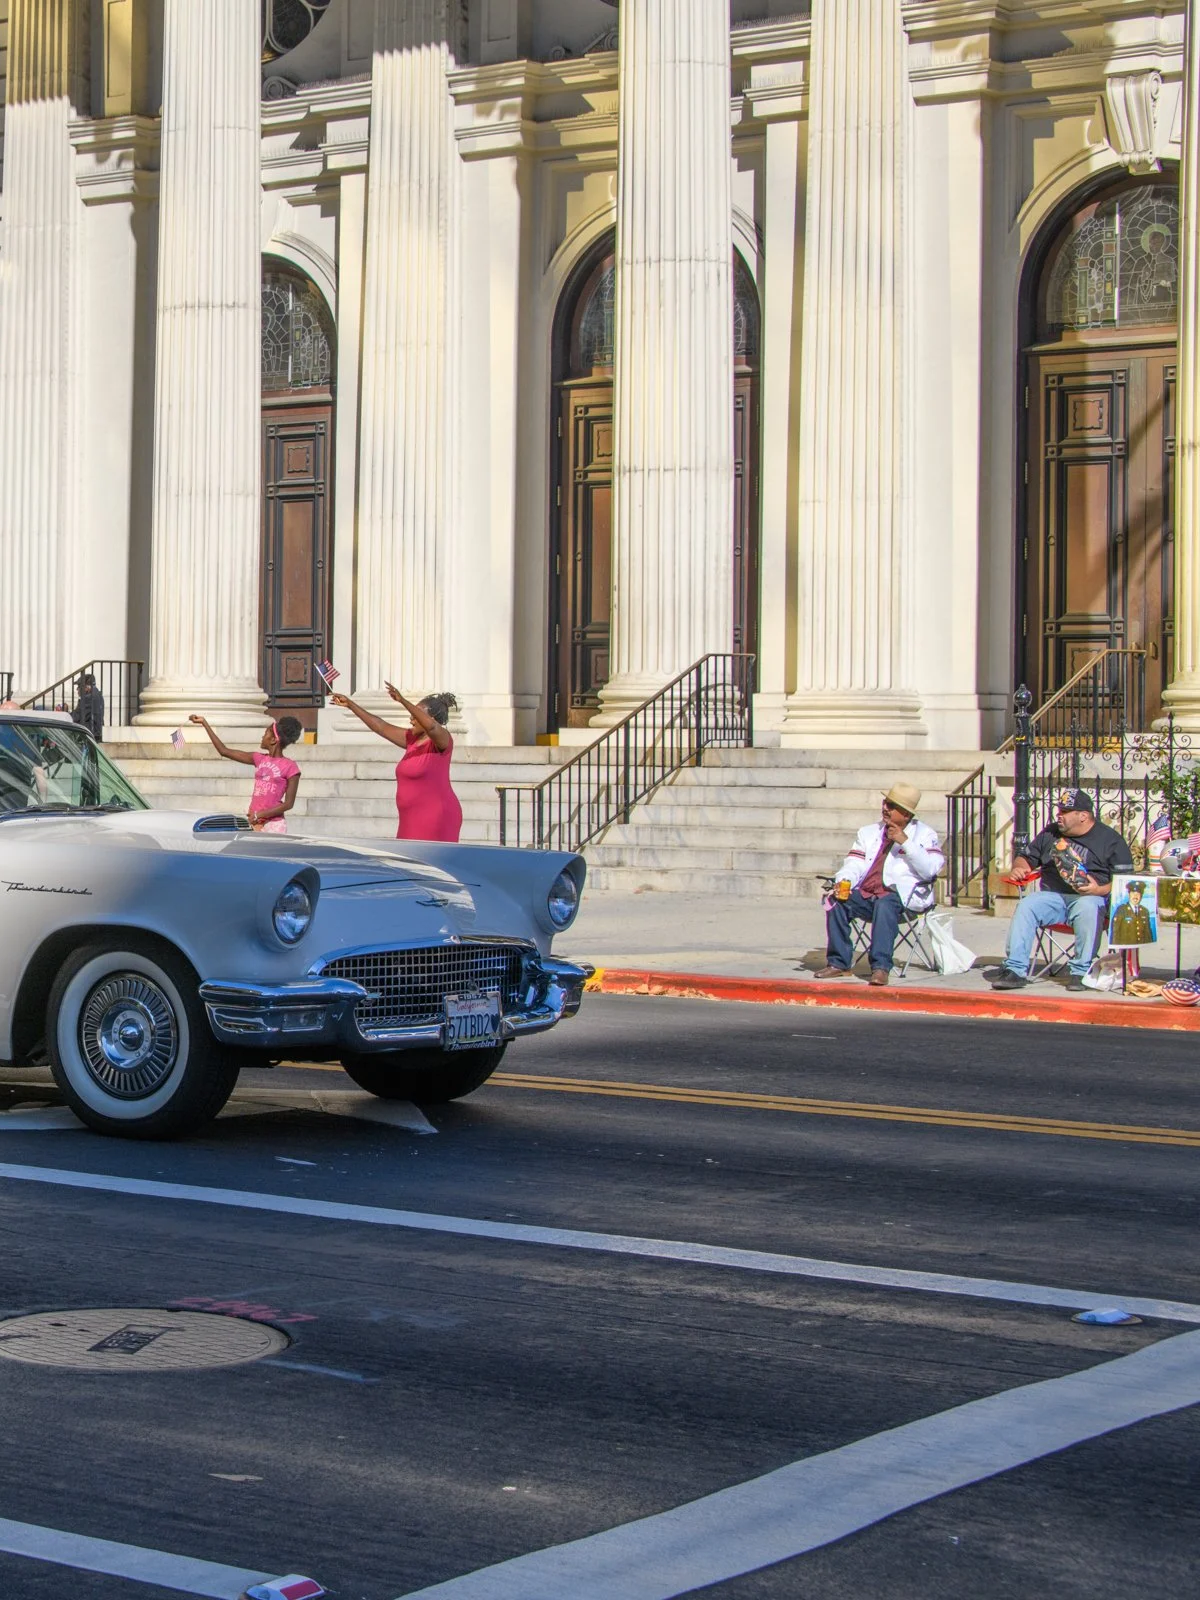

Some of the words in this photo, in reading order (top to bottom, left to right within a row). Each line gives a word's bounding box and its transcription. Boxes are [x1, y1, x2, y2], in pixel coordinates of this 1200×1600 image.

[1, 880, 92, 897] Thunderbird
[456, 1000, 489, 1013] California
[451, 1040, 497, 1050] Thunderbird
